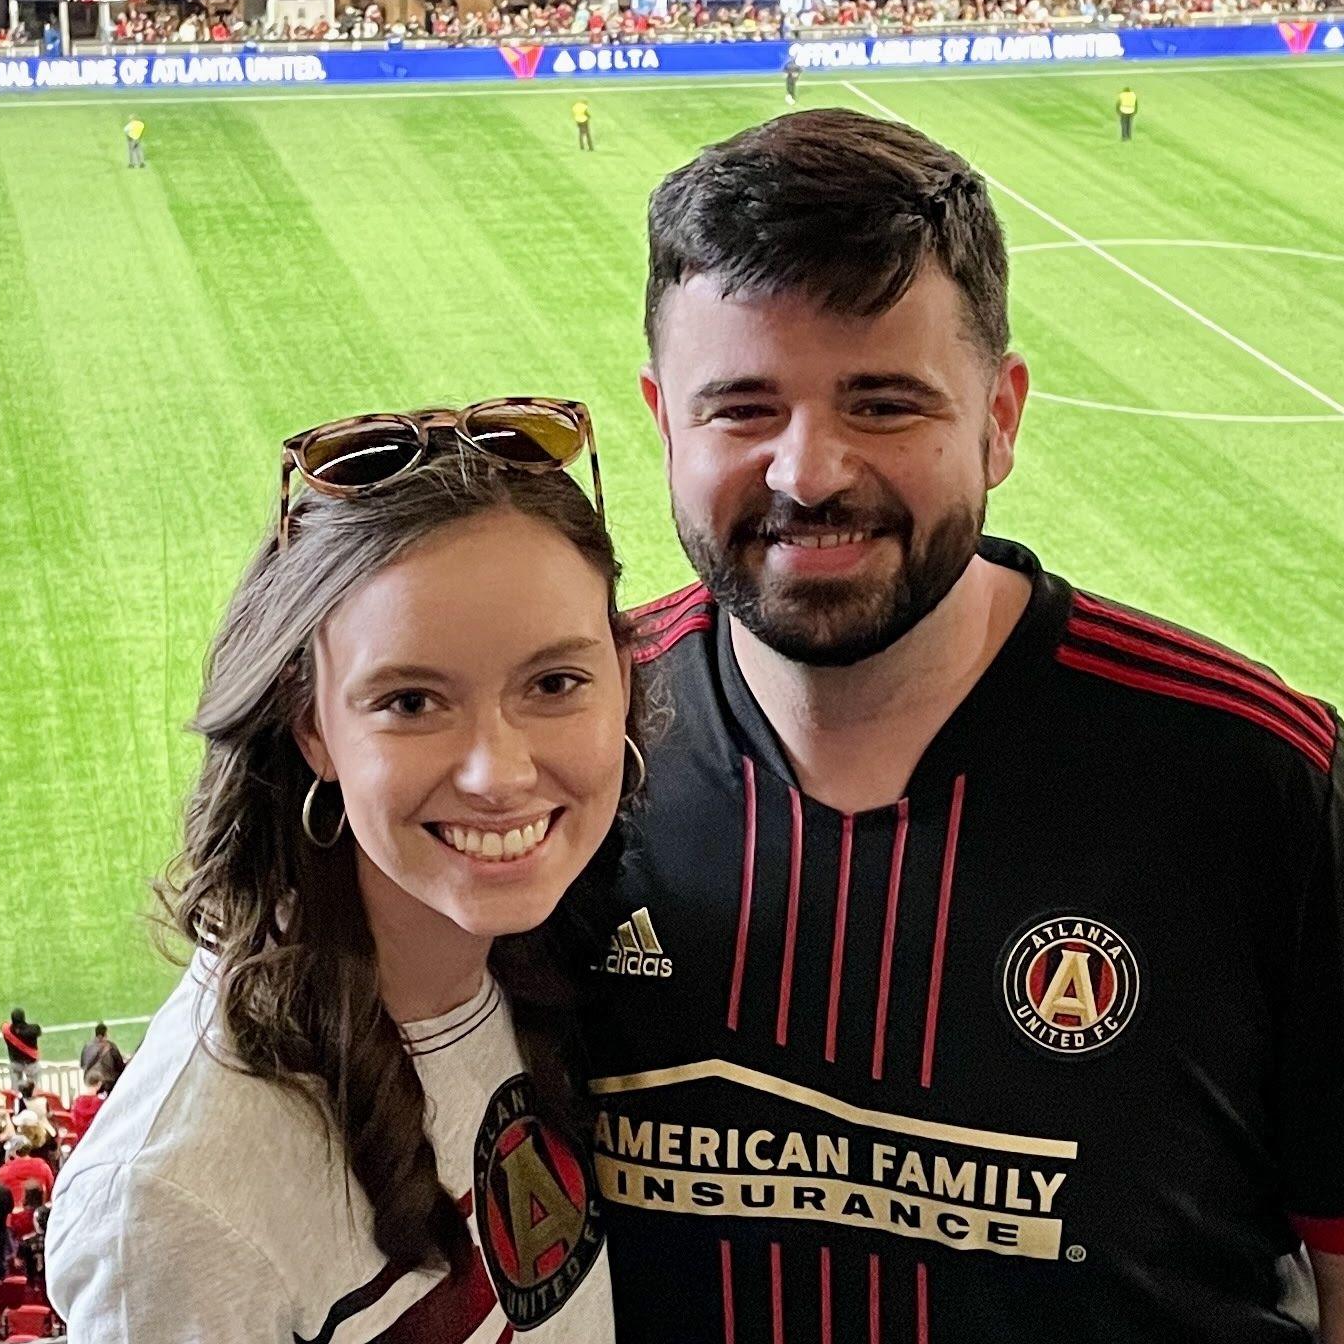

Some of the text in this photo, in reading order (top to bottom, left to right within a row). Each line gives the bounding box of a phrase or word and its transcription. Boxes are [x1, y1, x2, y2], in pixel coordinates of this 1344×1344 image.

[35, 59, 117, 86] AIRLINE
[119, 59, 149, 85] OF
[151, 56, 245, 83] ATLANTA
[578, 48, 659, 71] DELTA
[1031, 922, 1122, 960] ATLANTA
[590, 952, 673, 978] didas
[1016, 1004, 1119, 1048] UNITED FC
[593, 1108, 1067, 1213] AMERICAN FAMILY
[615, 1169, 1020, 1248] INSURANCE
[506, 1256, 582, 1321] UNITED
